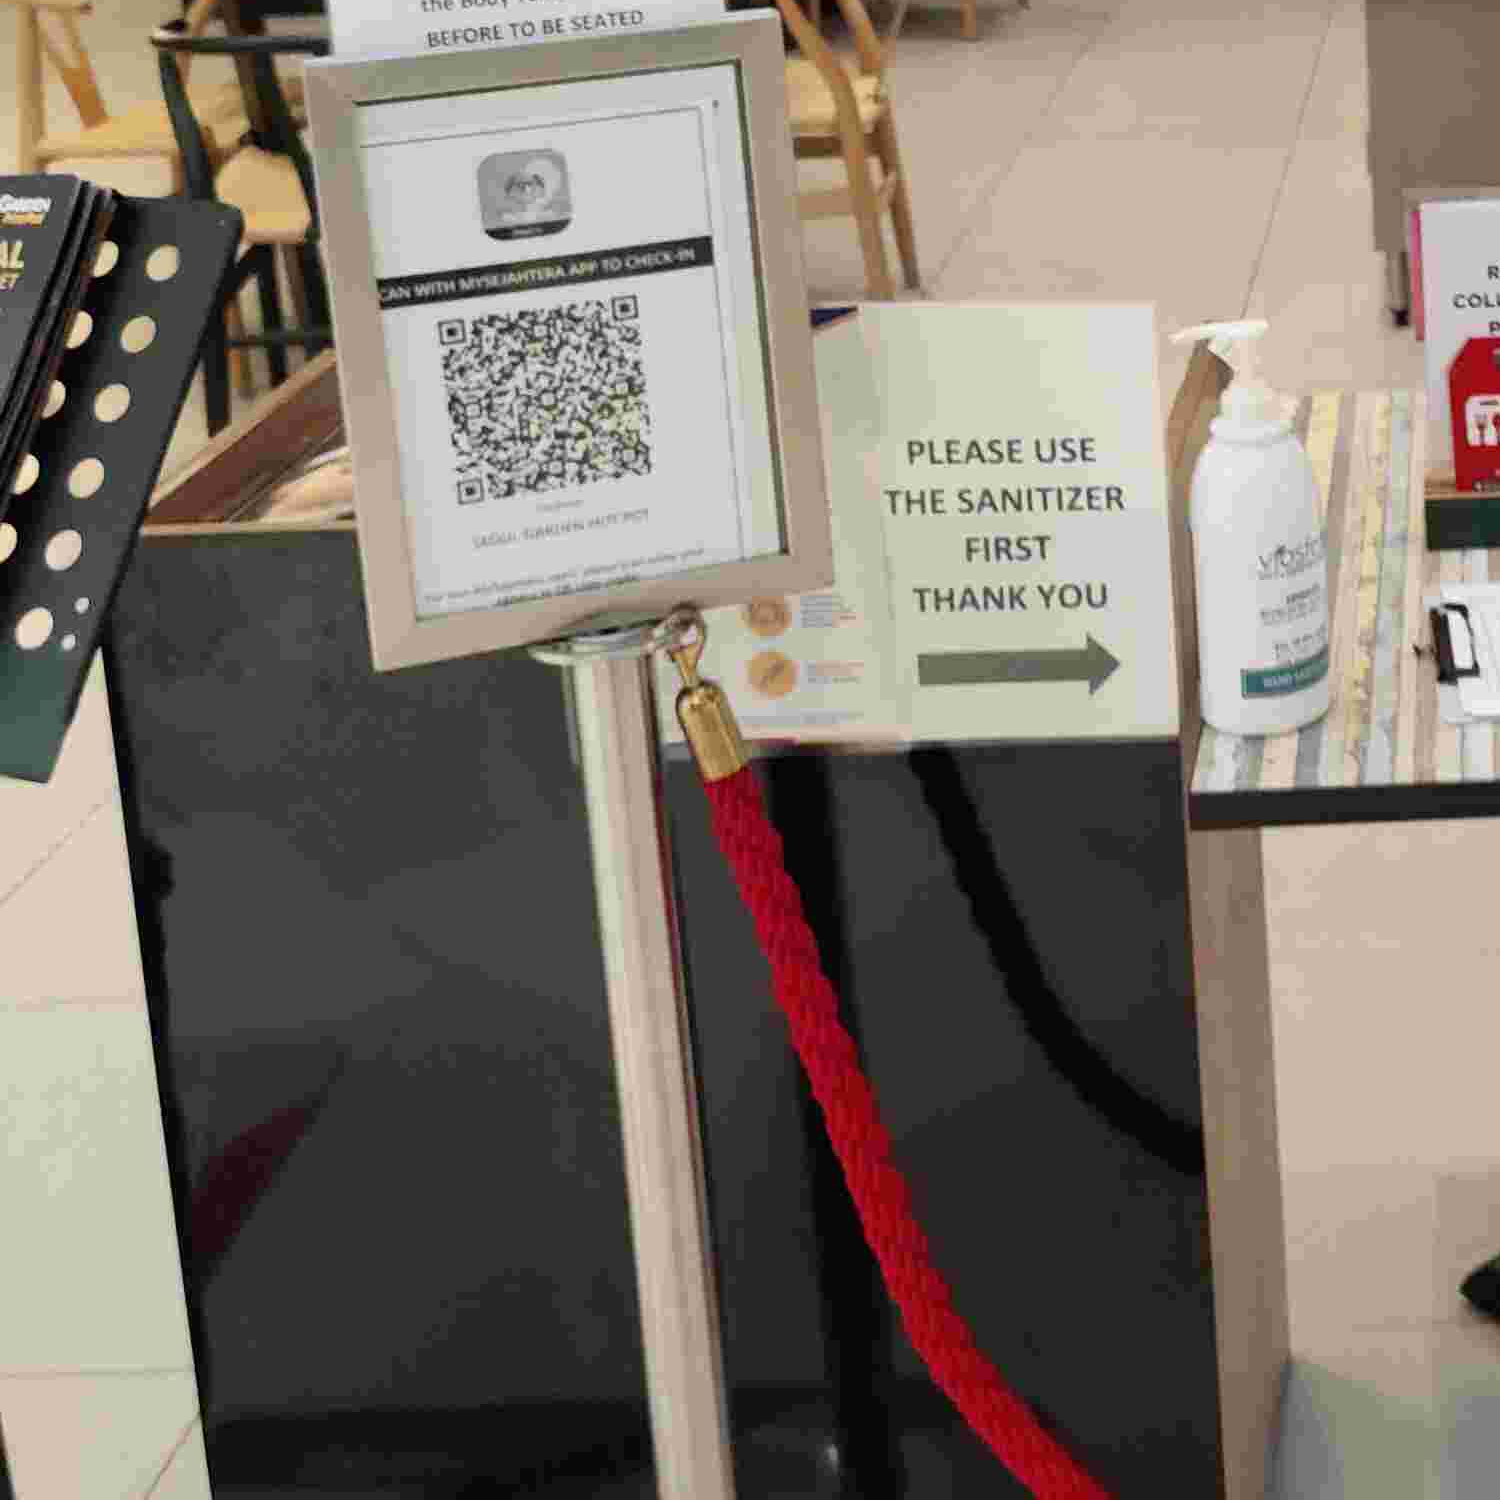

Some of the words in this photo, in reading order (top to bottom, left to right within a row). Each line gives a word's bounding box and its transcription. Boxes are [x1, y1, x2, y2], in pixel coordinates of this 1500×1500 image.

[427, 24, 505, 49] BEFORE
[509, 20, 536, 39] TO
[542, 16, 566, 36] BE
[570, 9, 645, 33] SEATED
[415, 277, 456, 298] WITH
[906, 438, 1024, 465] PLEASE
[1034, 437, 1097, 464] USE
[885, 488, 948, 516] THE
[956, 485, 1127, 515] SANITIZER
[965, 535, 1052, 563] FIRST
[912, 585, 1028, 613] THANK
[1037, 582, 1108, 610] YOU
